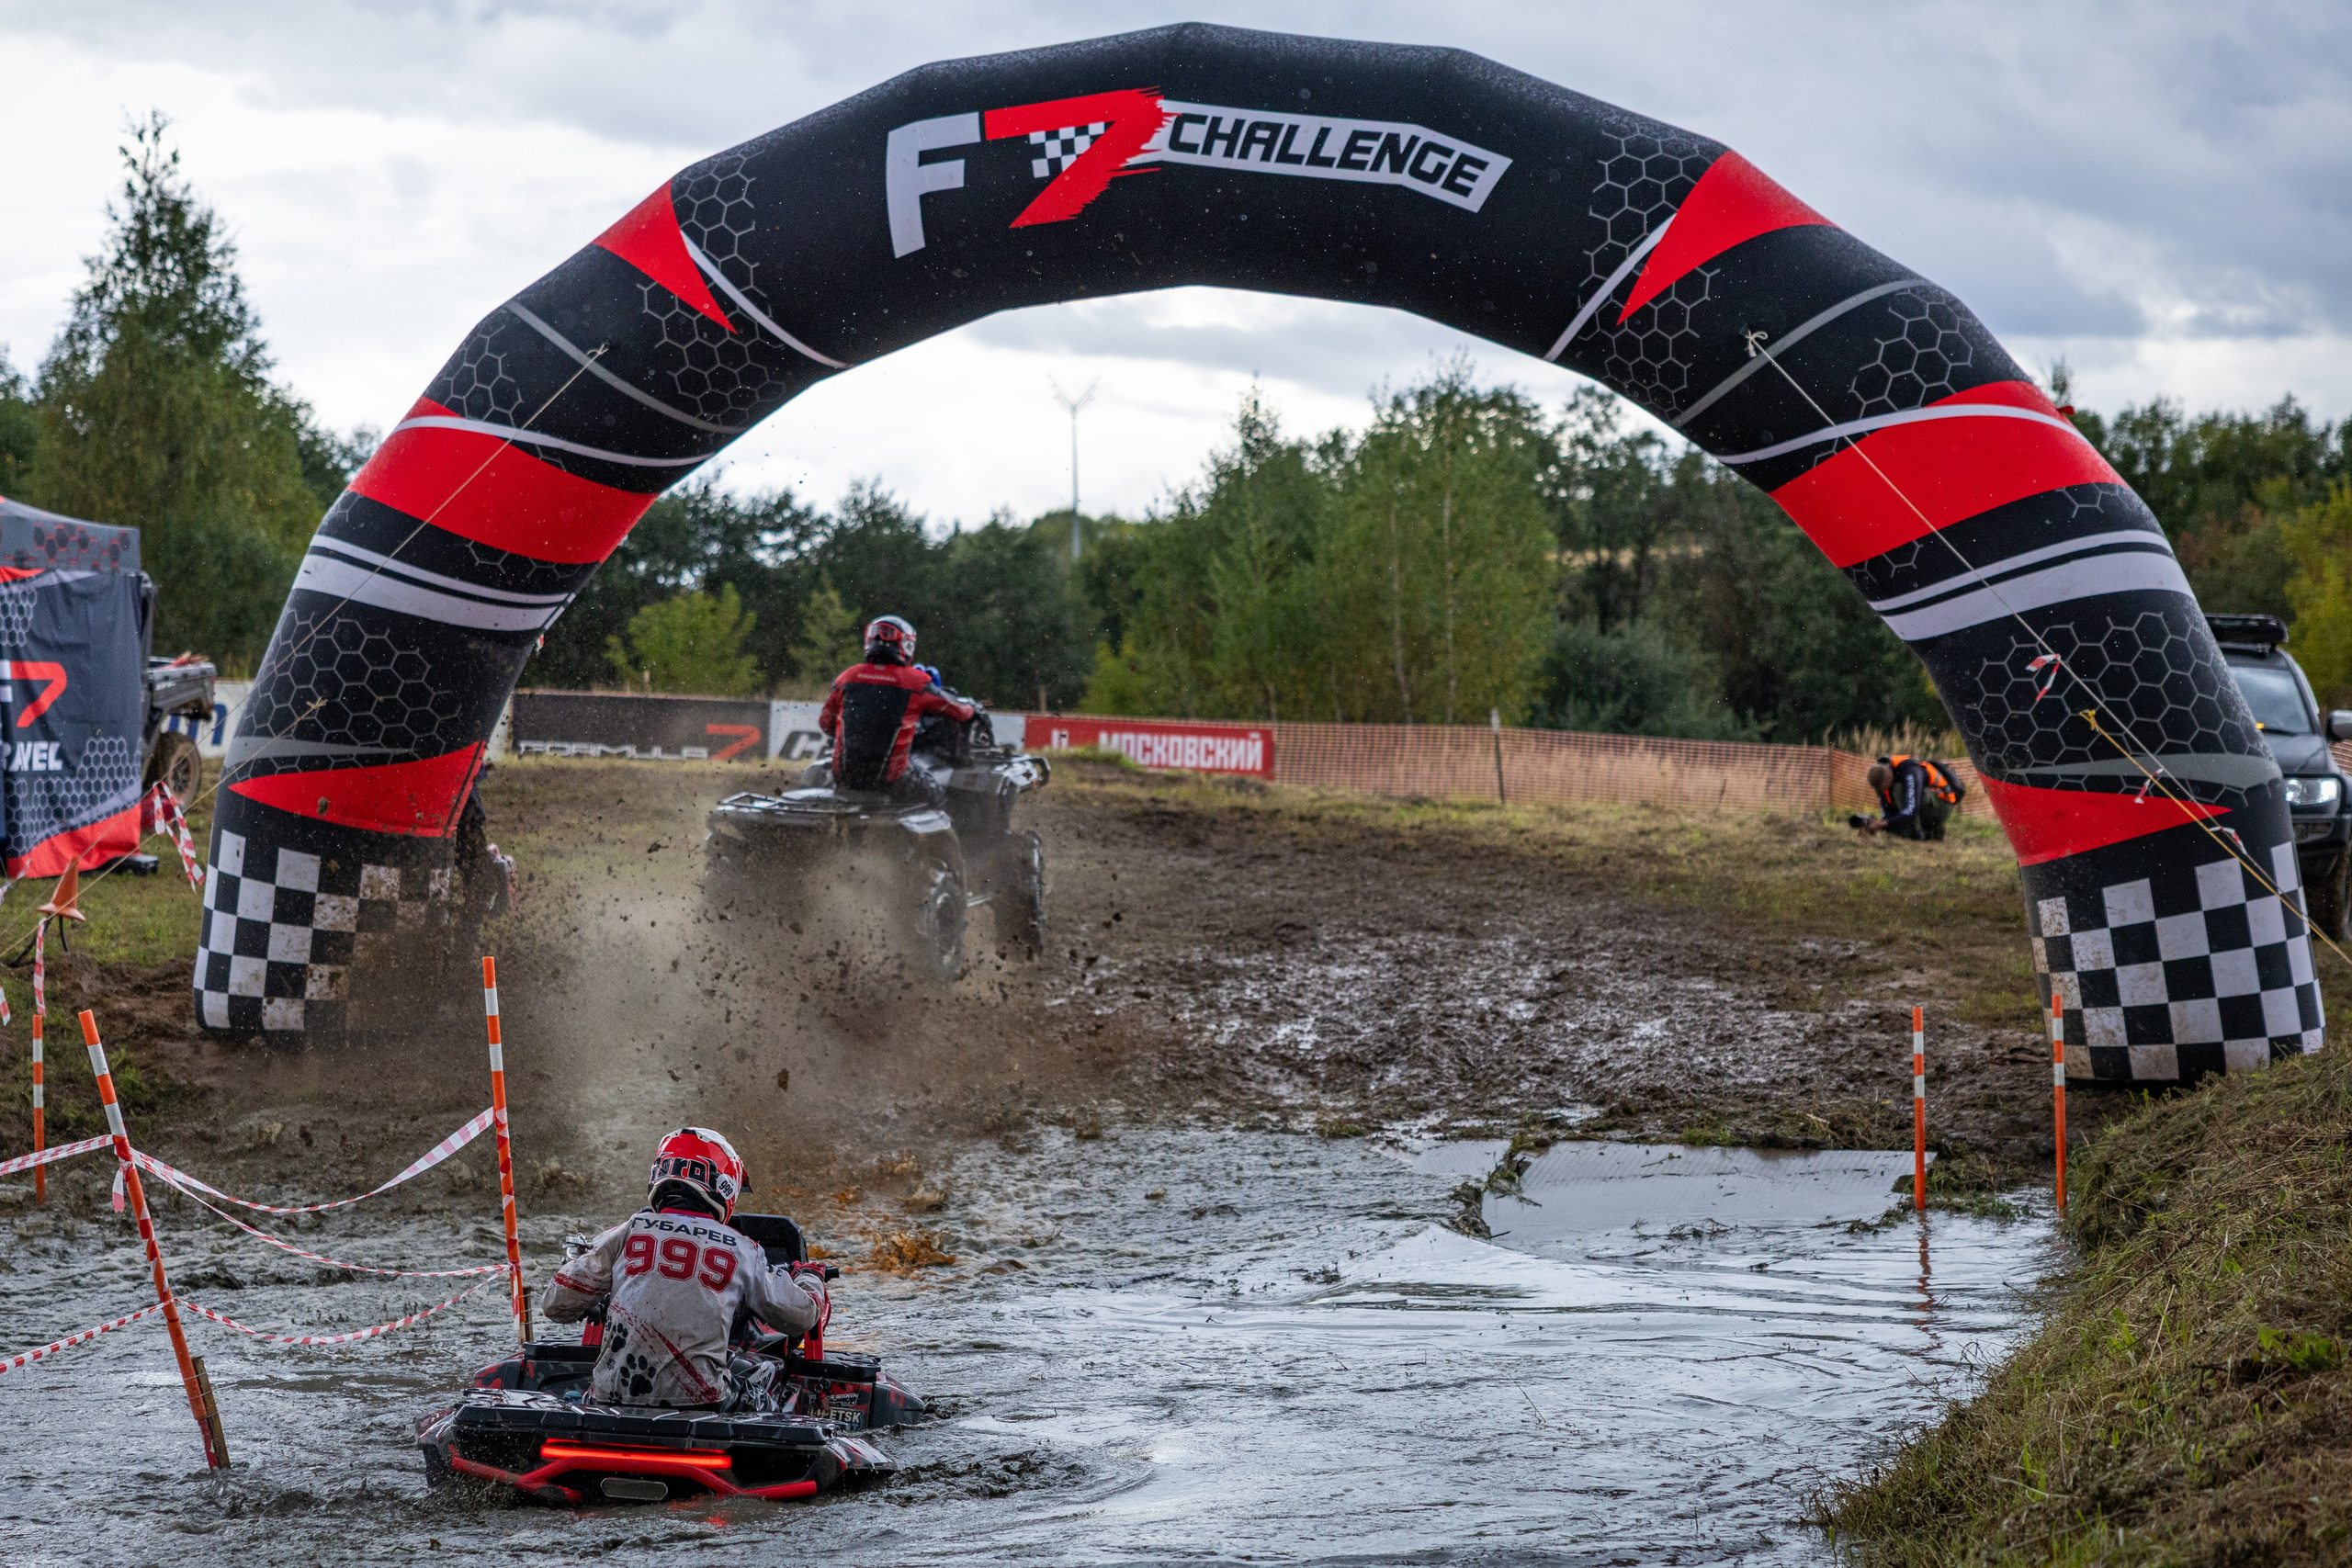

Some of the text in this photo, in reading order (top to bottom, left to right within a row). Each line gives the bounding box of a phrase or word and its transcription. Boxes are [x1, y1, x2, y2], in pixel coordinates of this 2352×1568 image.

[1168, 113, 1488, 197] CHALLENGE
[1099, 732, 1263, 771] МОСКОВСКИЙ
[718, 1179, 734, 1198] 999
[631, 1217, 737, 1247] ГУБАРЕВ
[624, 1234, 739, 1293] 999
